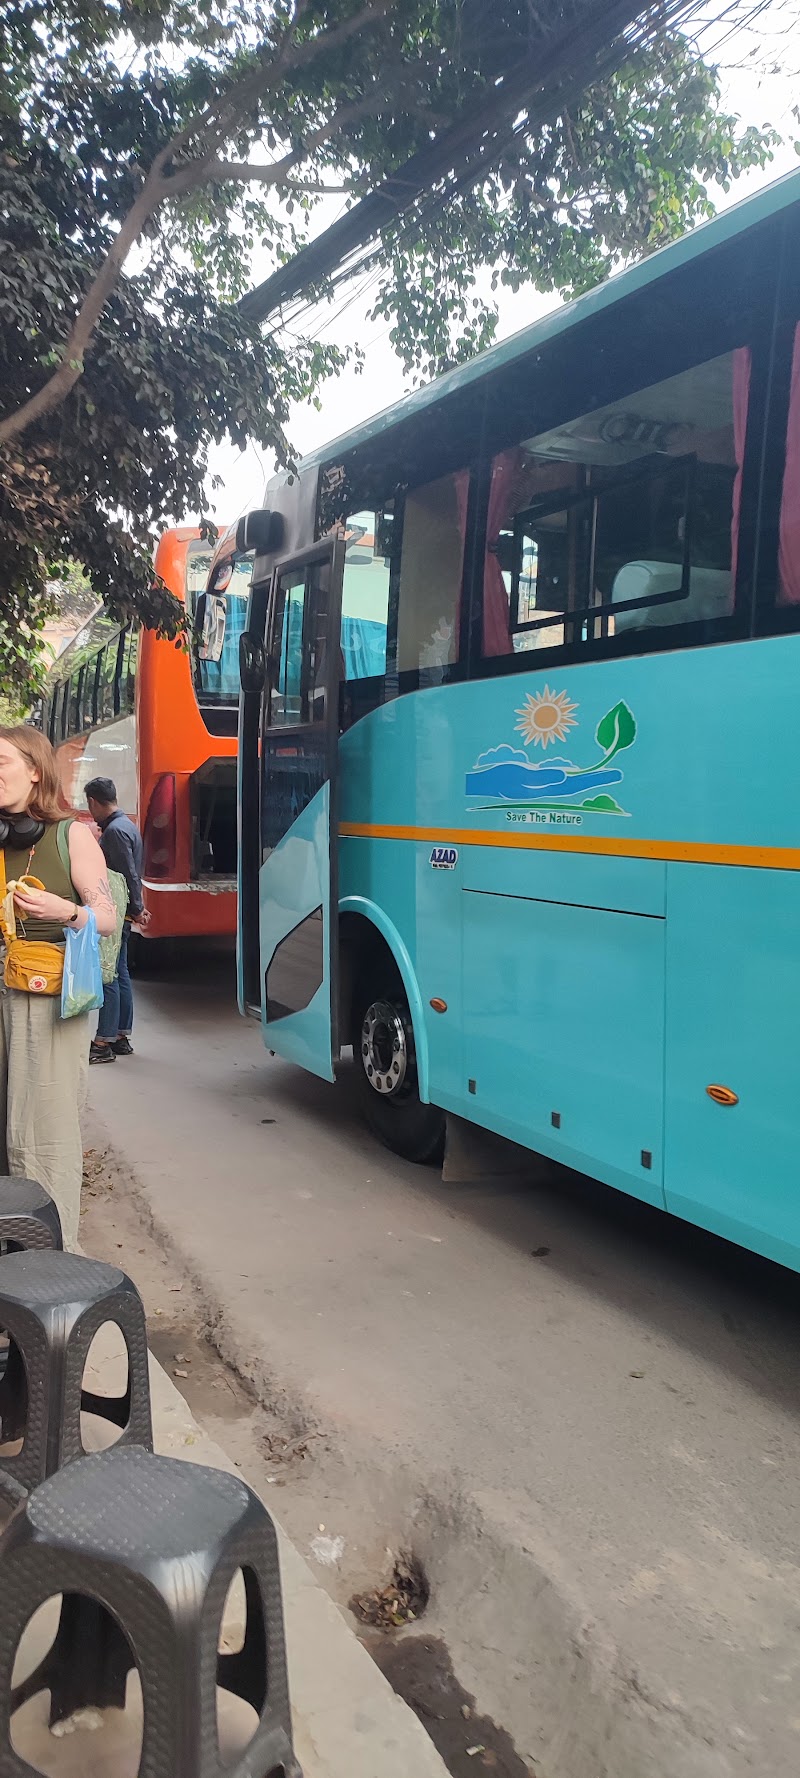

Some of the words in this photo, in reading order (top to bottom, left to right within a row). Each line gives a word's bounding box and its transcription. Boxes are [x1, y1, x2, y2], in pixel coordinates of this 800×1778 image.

[506, 811, 527, 822] Save
[529, 812, 546, 823] The
[549, 812, 582, 824] Nature
[430, 848, 456, 863] AZAD
